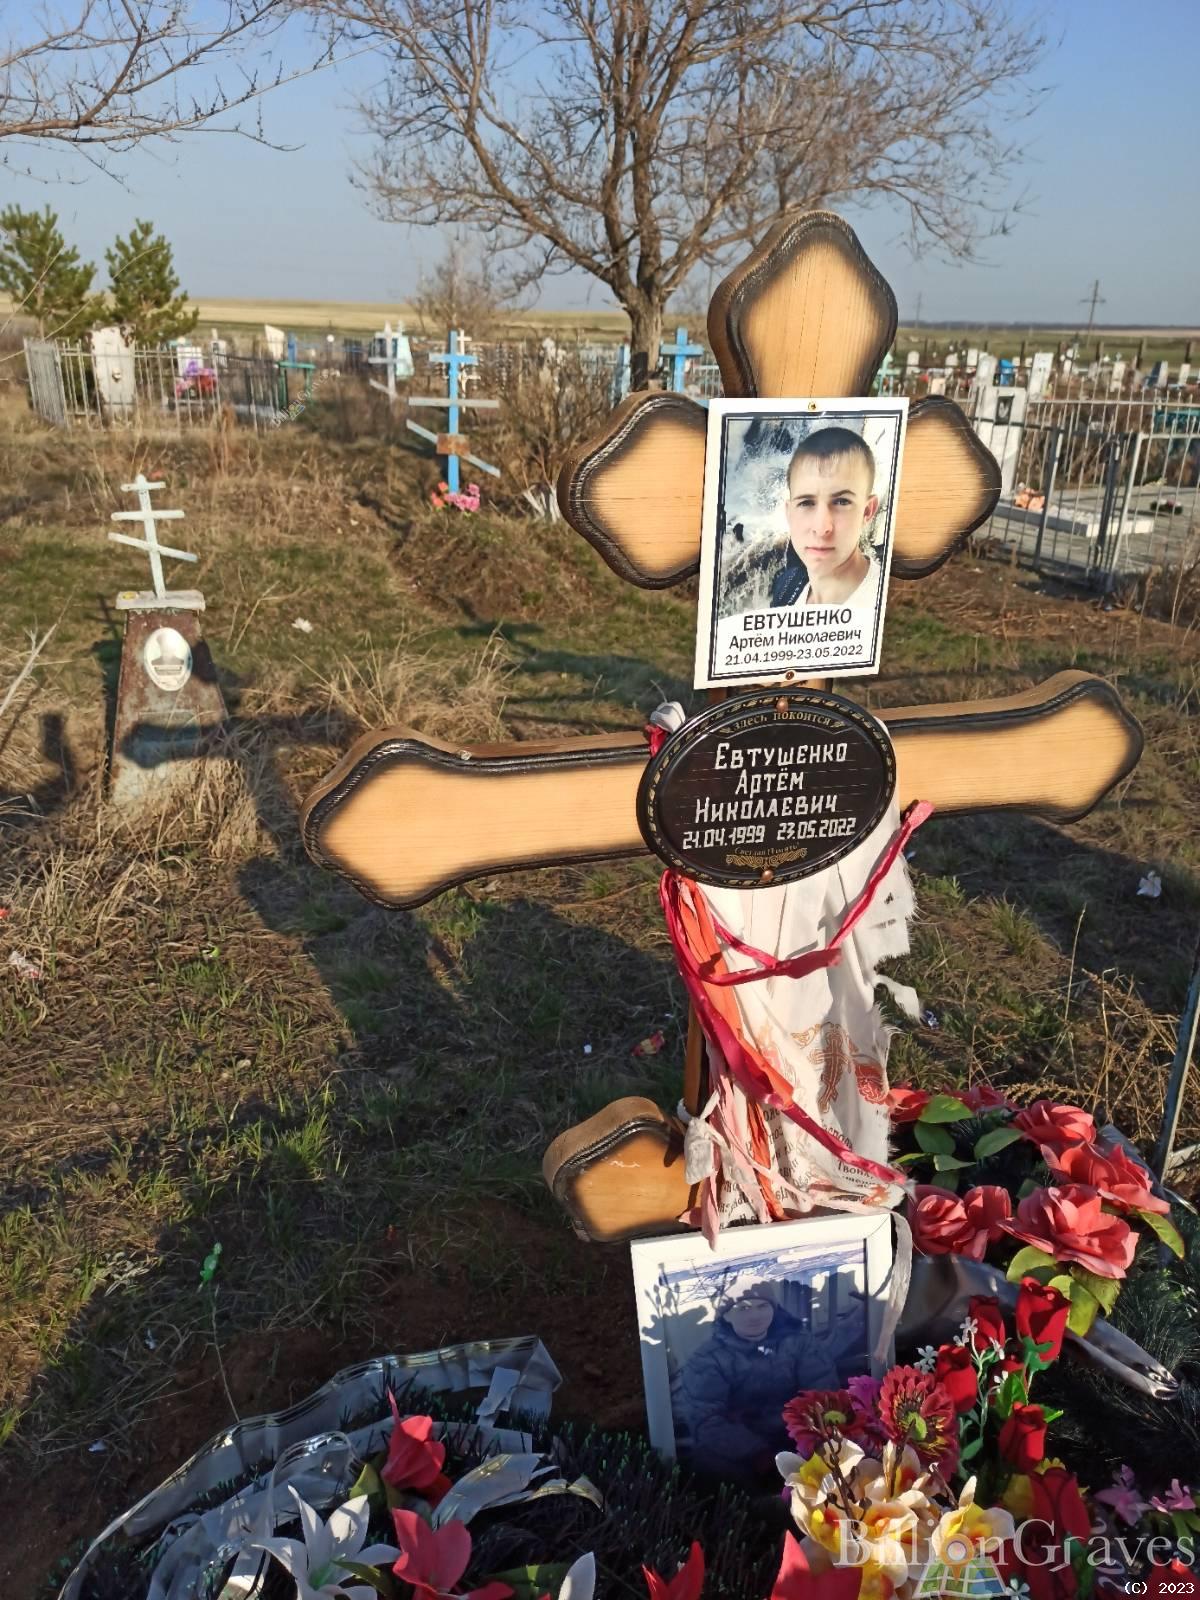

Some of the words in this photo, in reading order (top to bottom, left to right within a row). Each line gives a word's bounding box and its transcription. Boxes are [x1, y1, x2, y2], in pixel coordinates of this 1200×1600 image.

[743, 608, 853, 631] ЕВТУШЕНКО
[729, 635, 774, 652] Артём
[778, 629, 862, 646] Николаевич
[725, 644, 864, 666] 21.04.1999-23.05.2022
[682, 825, 766, 850] 21.04.1999
[776, 817, 857, 841] 23.05.2022
